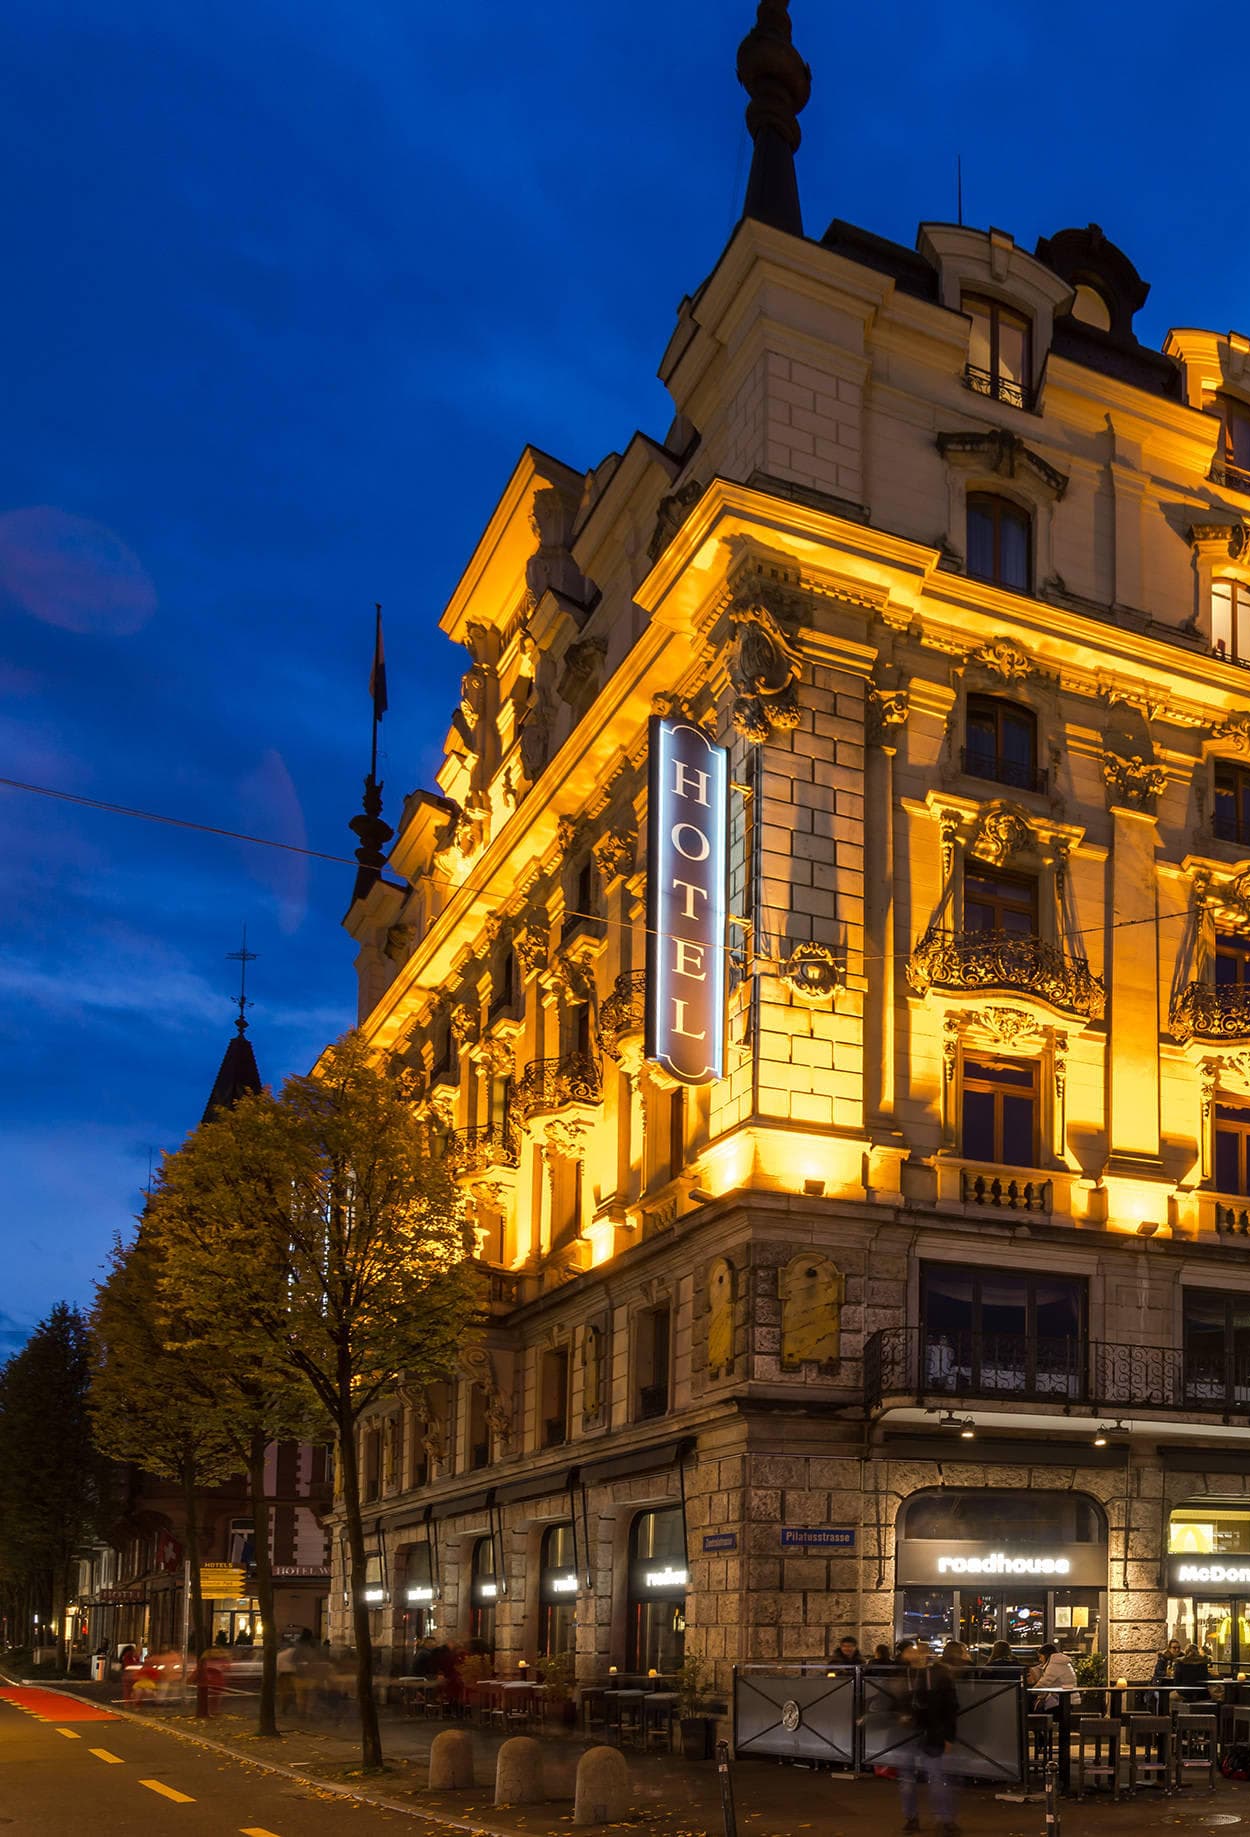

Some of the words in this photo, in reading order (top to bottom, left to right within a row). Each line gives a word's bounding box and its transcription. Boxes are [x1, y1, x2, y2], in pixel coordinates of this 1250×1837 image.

[671, 758, 712, 1040] HOTEL
[786, 1531, 850, 1542] Pilatusstrasse
[276, 1567, 314, 1575] HOTEL
[938, 1553, 1070, 1574] roadhouse
